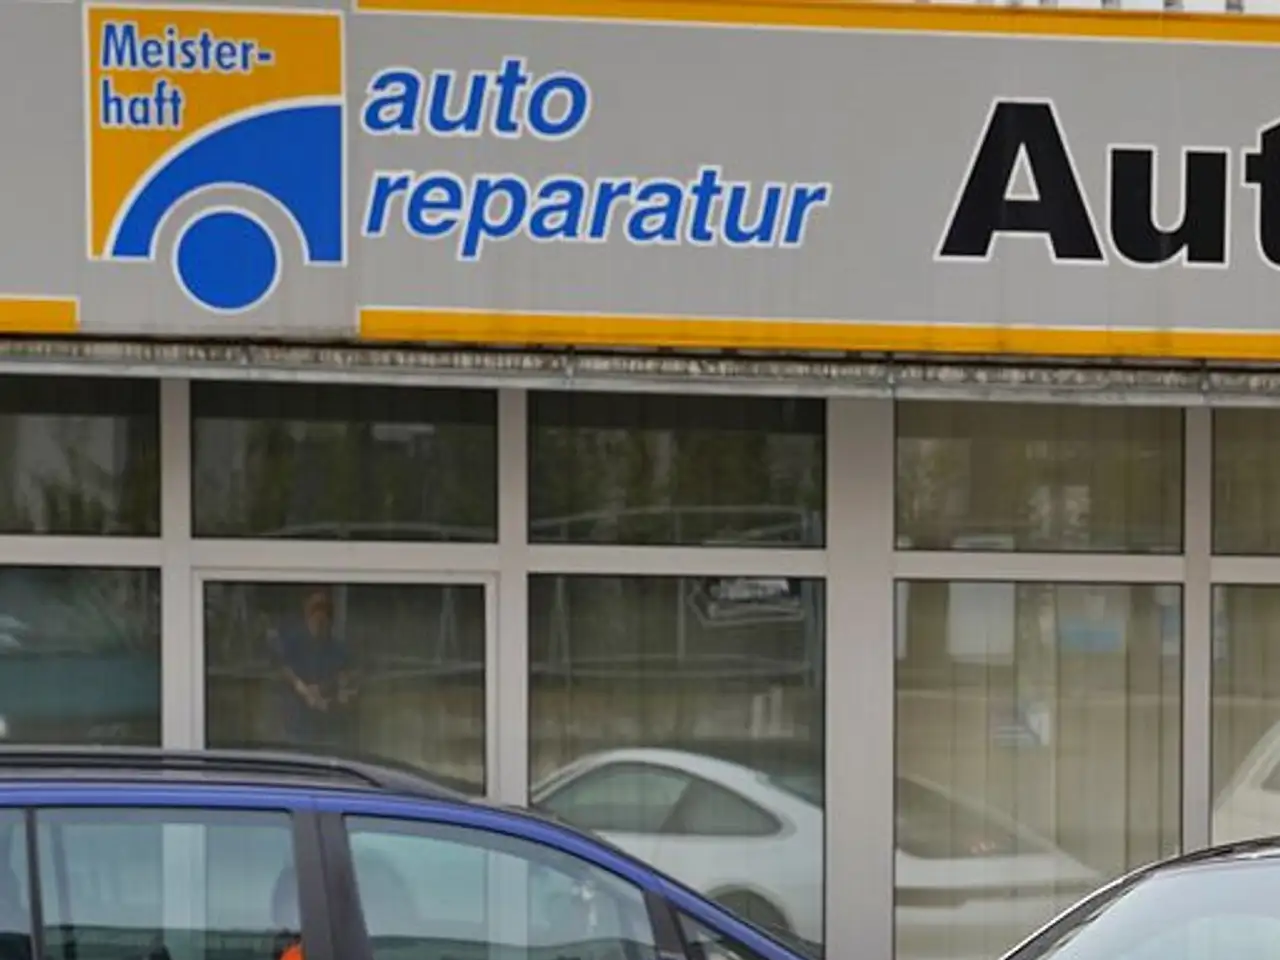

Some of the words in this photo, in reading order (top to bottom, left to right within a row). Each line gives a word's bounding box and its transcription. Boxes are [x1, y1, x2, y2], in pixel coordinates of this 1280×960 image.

[101, 22, 273, 72] Meister-
[101, 78, 183, 128] haft
[361, 58, 590, 137] auto
[364, 168, 829, 259] reparatur
